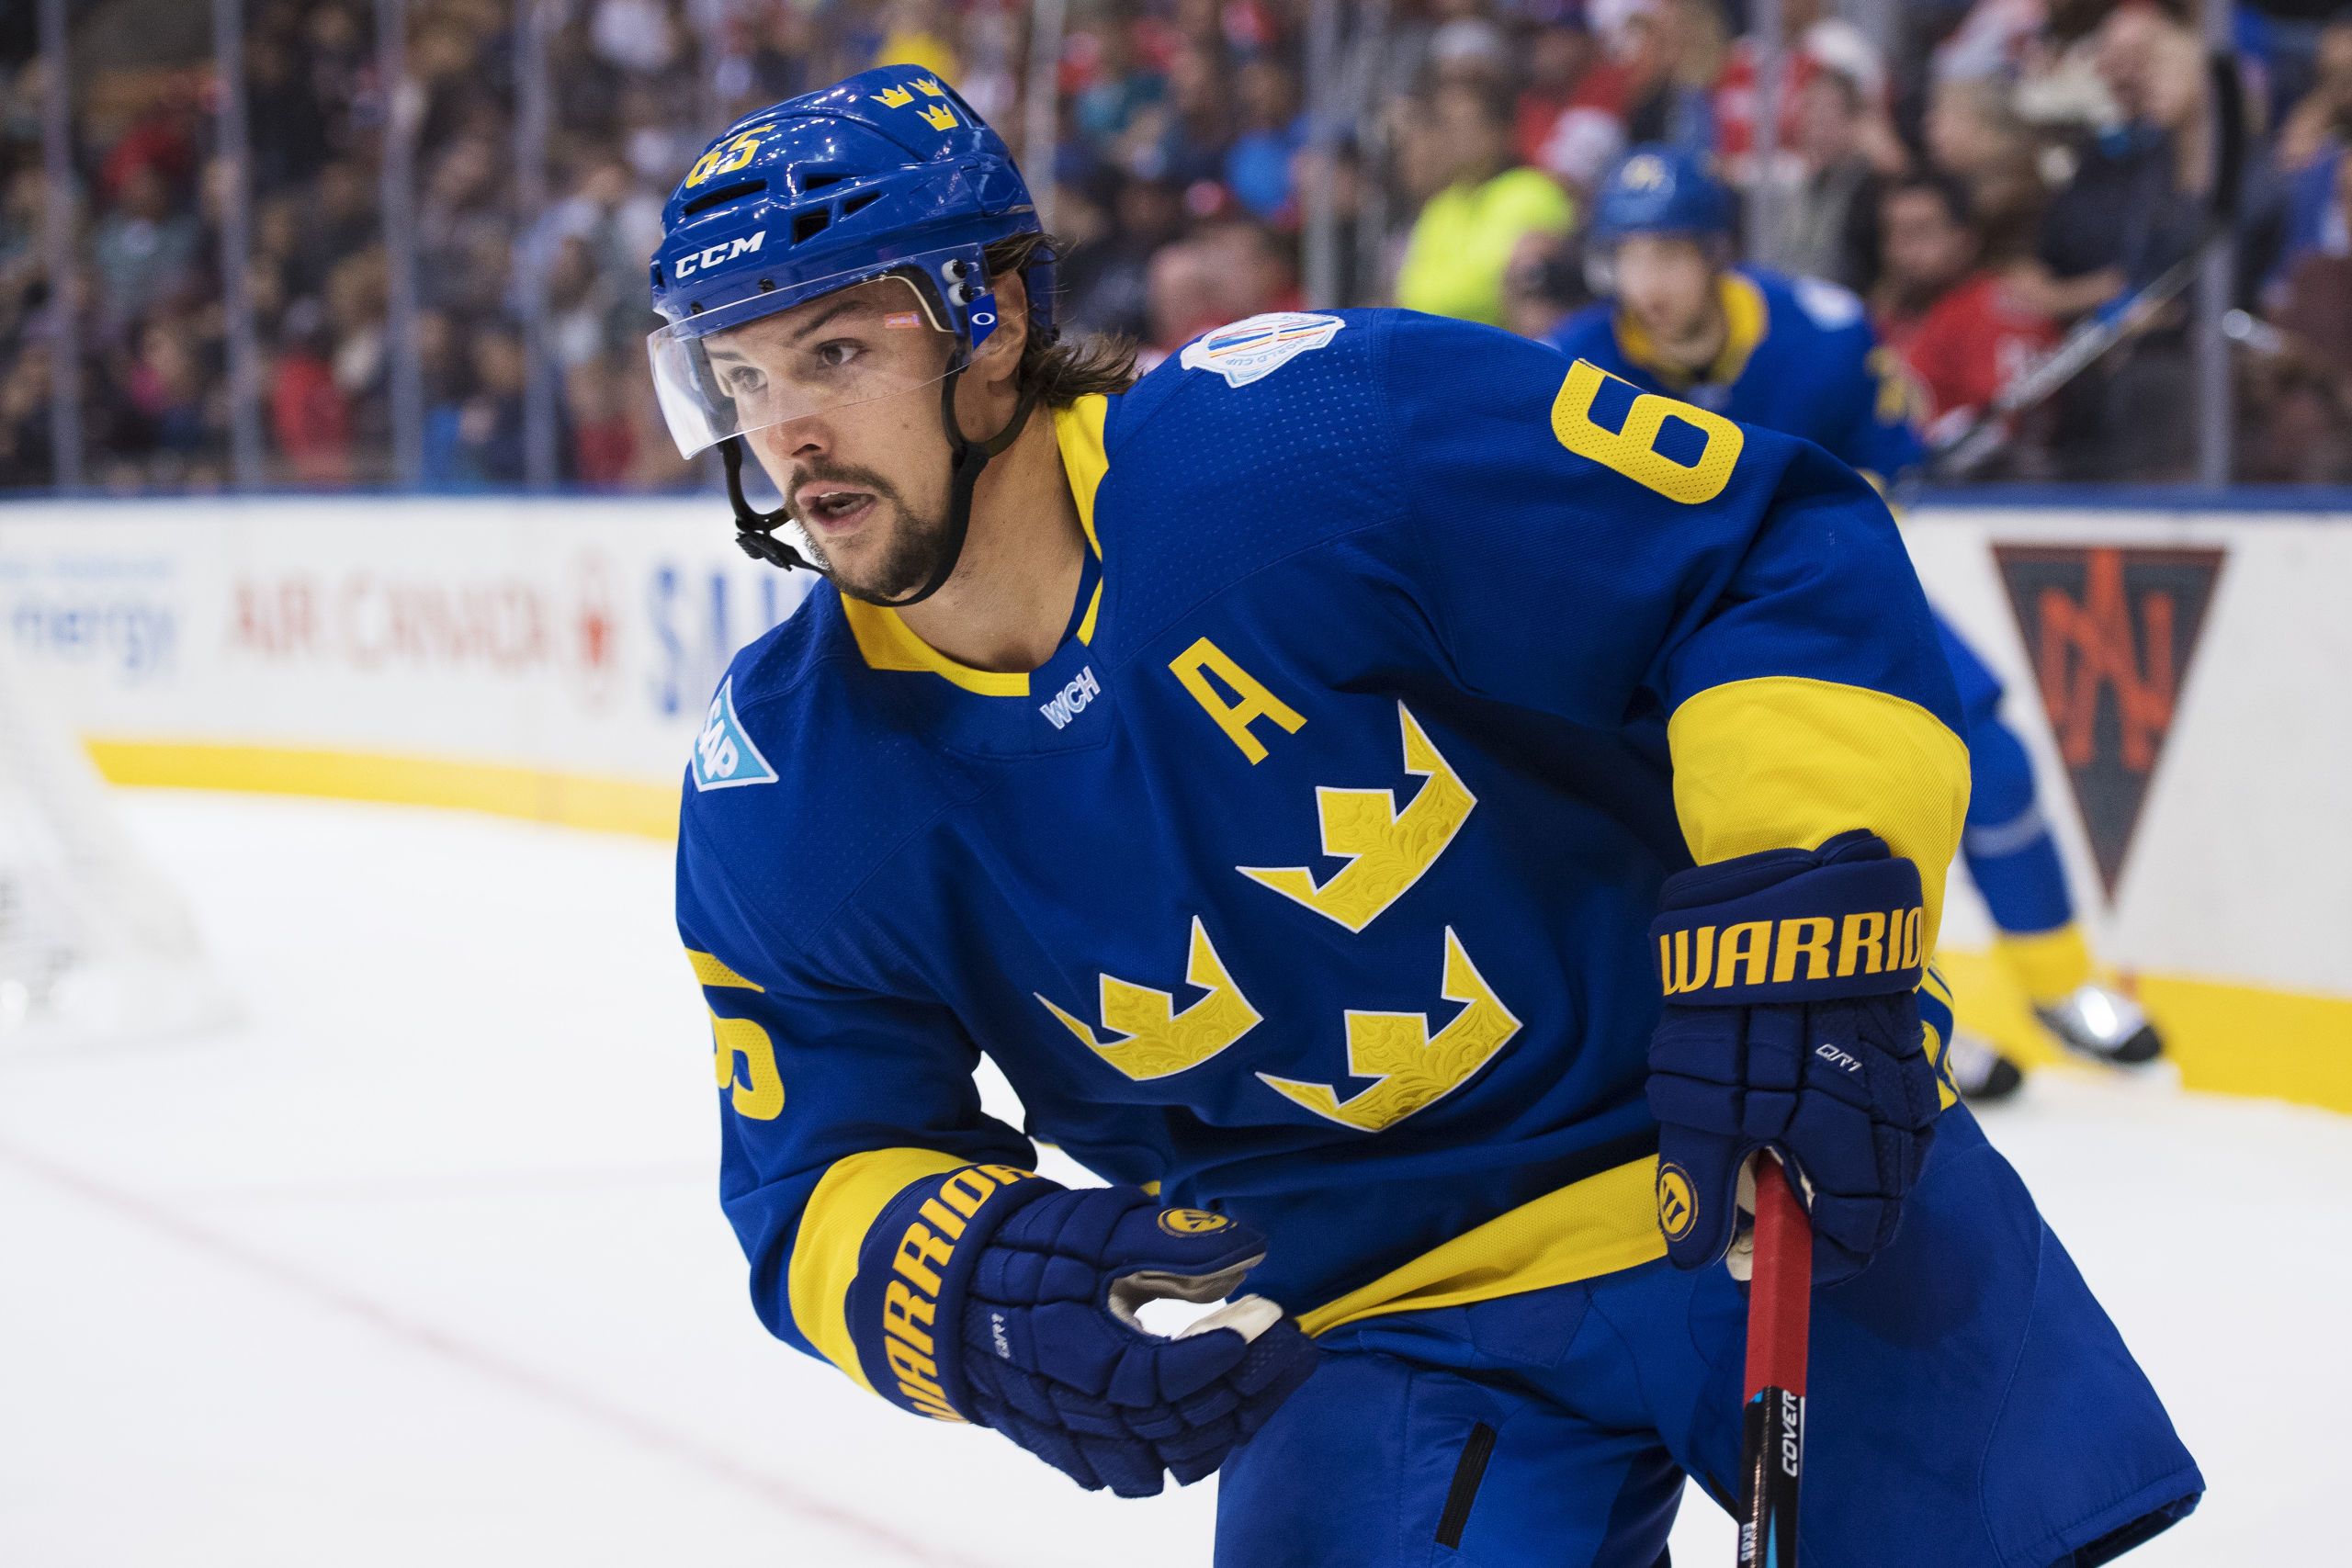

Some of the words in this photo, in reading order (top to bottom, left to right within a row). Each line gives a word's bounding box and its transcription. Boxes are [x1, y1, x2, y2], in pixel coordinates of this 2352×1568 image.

[685, 124, 776, 189] 65
[675, 231, 766, 279] CCM
[1551, 357, 1745, 505] 6
[226, 573, 318, 655] AIR
[1039, 665, 1101, 729] WCH
[1168, 637, 1308, 766] A
[698, 697, 740, 780] SAP
[1781, 1389, 1798, 1478] COVER
